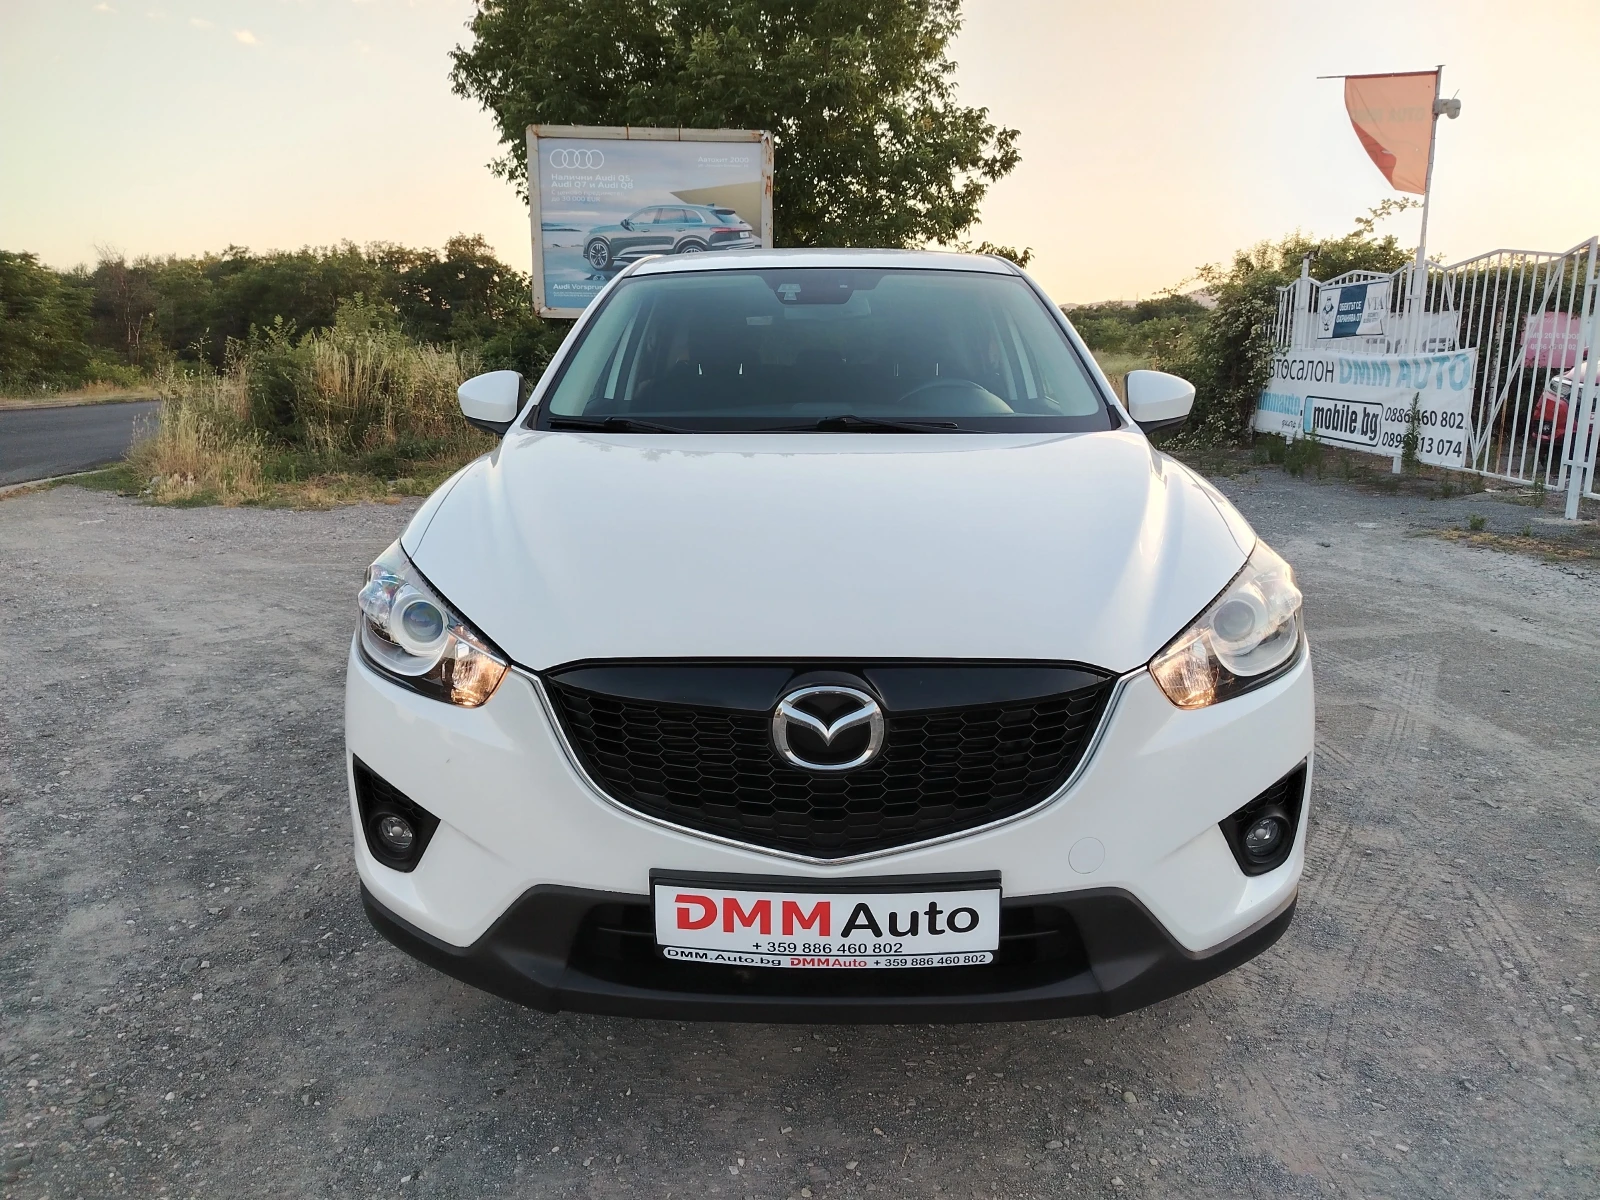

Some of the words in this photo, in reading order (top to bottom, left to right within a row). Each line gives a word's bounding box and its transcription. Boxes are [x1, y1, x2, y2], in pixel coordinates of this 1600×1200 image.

[551, 173, 592, 181] Налични
[595, 174, 616, 182] Audi
[574, 181, 587, 189] Q7
[597, 181, 618, 189] Audi
[620, 182, 634, 190] Q8
[1269, 358, 1334, 383] втосалон
[1338, 357, 1392, 388] DMM
[1395, 353, 1471, 392] AUTO
[1313, 403, 1380, 441] mobile.bg
[1440, 411, 1464, 429] 802
[1436, 439, 1462, 458] 074
[767, 941, 797, 953] 359
[802, 942, 832, 954] 886
[836, 943, 868, 954] 460
[872, 942, 903, 953] 802
[667, 949, 782, 966] DMM.Auto.bg
[884, 958, 907, 967] 359
[911, 957, 934, 966] 886
[937, 956, 960, 965] 460
[963, 954, 986, 964] 802
